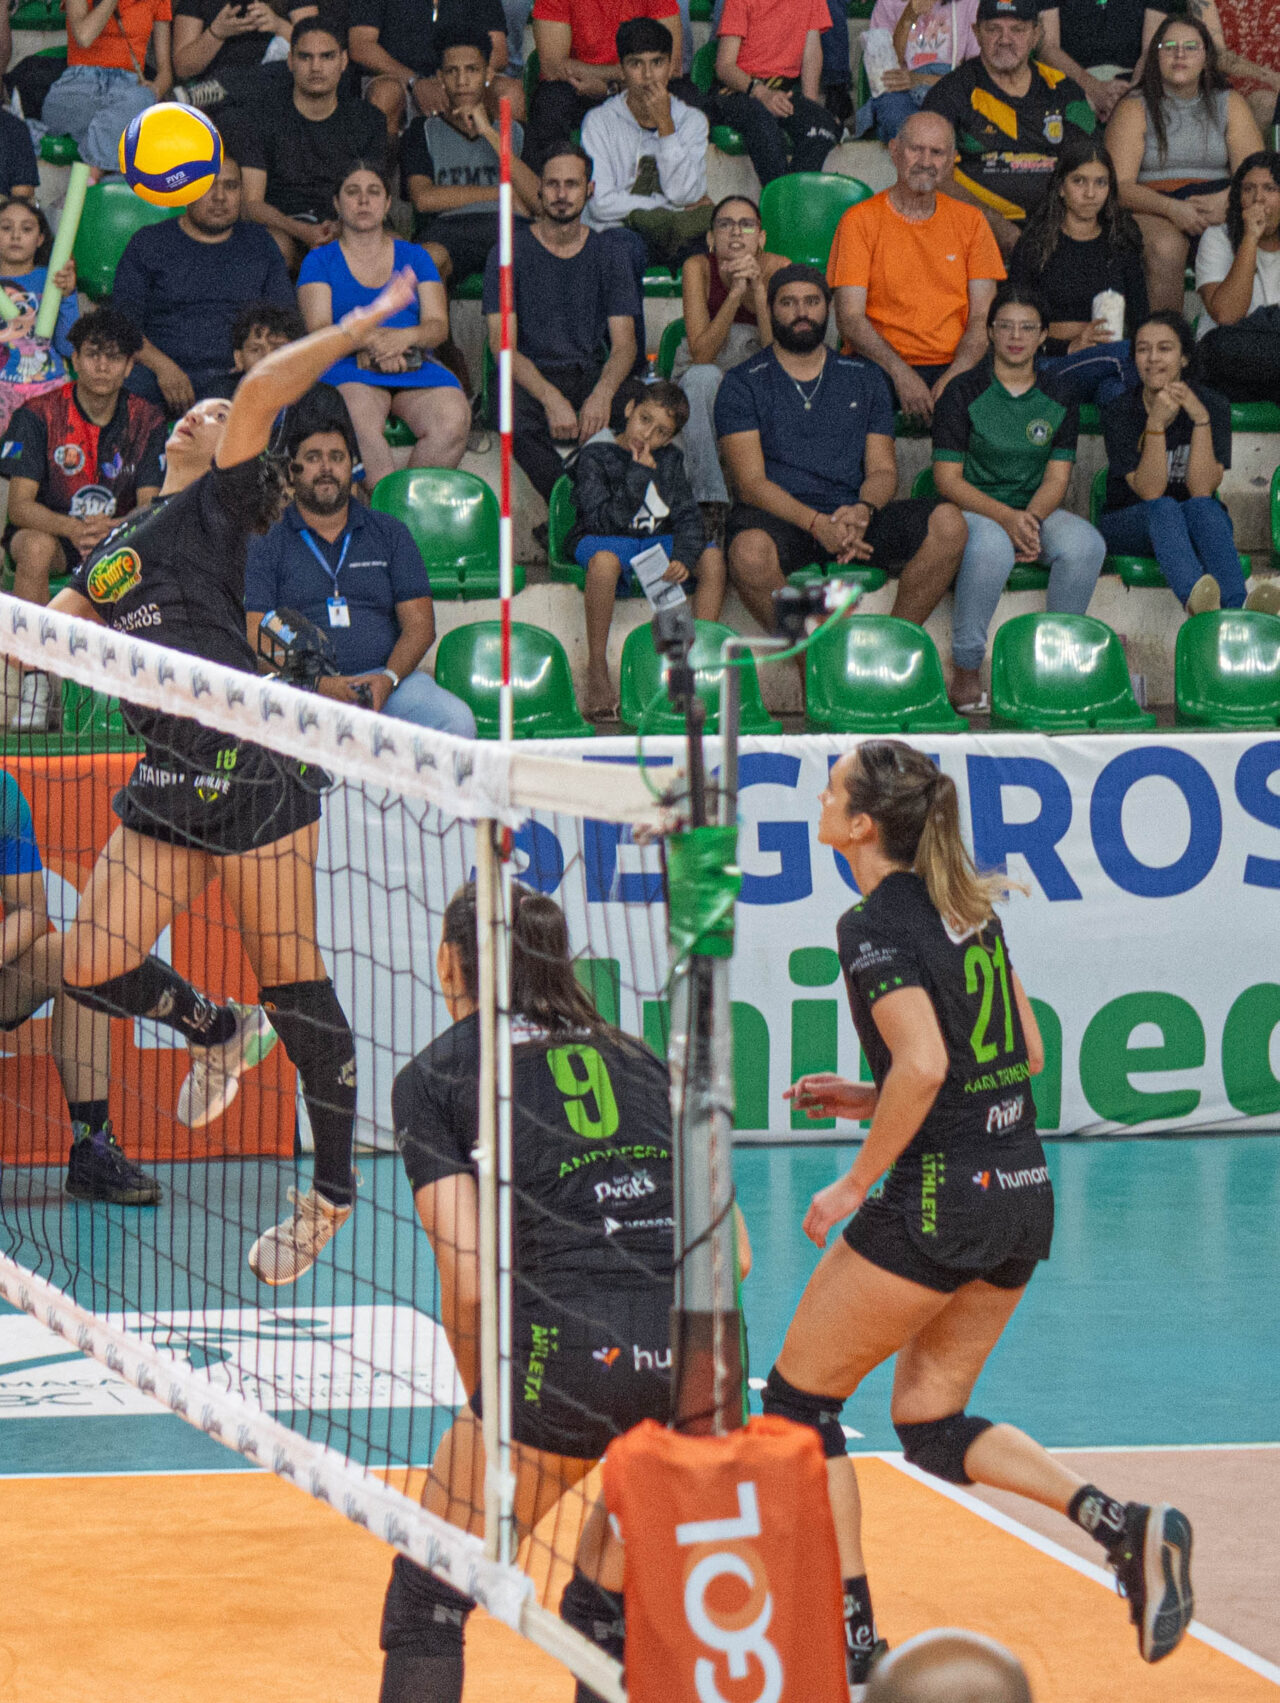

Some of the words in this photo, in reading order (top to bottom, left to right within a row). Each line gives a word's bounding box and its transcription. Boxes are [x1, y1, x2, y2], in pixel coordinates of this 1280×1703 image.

[166, 170, 186, 184] FIVB
[963, 935, 1015, 1064] 21
[546, 1043, 619, 1139] 9
[921, 1152, 938, 1234] ATHLETA
